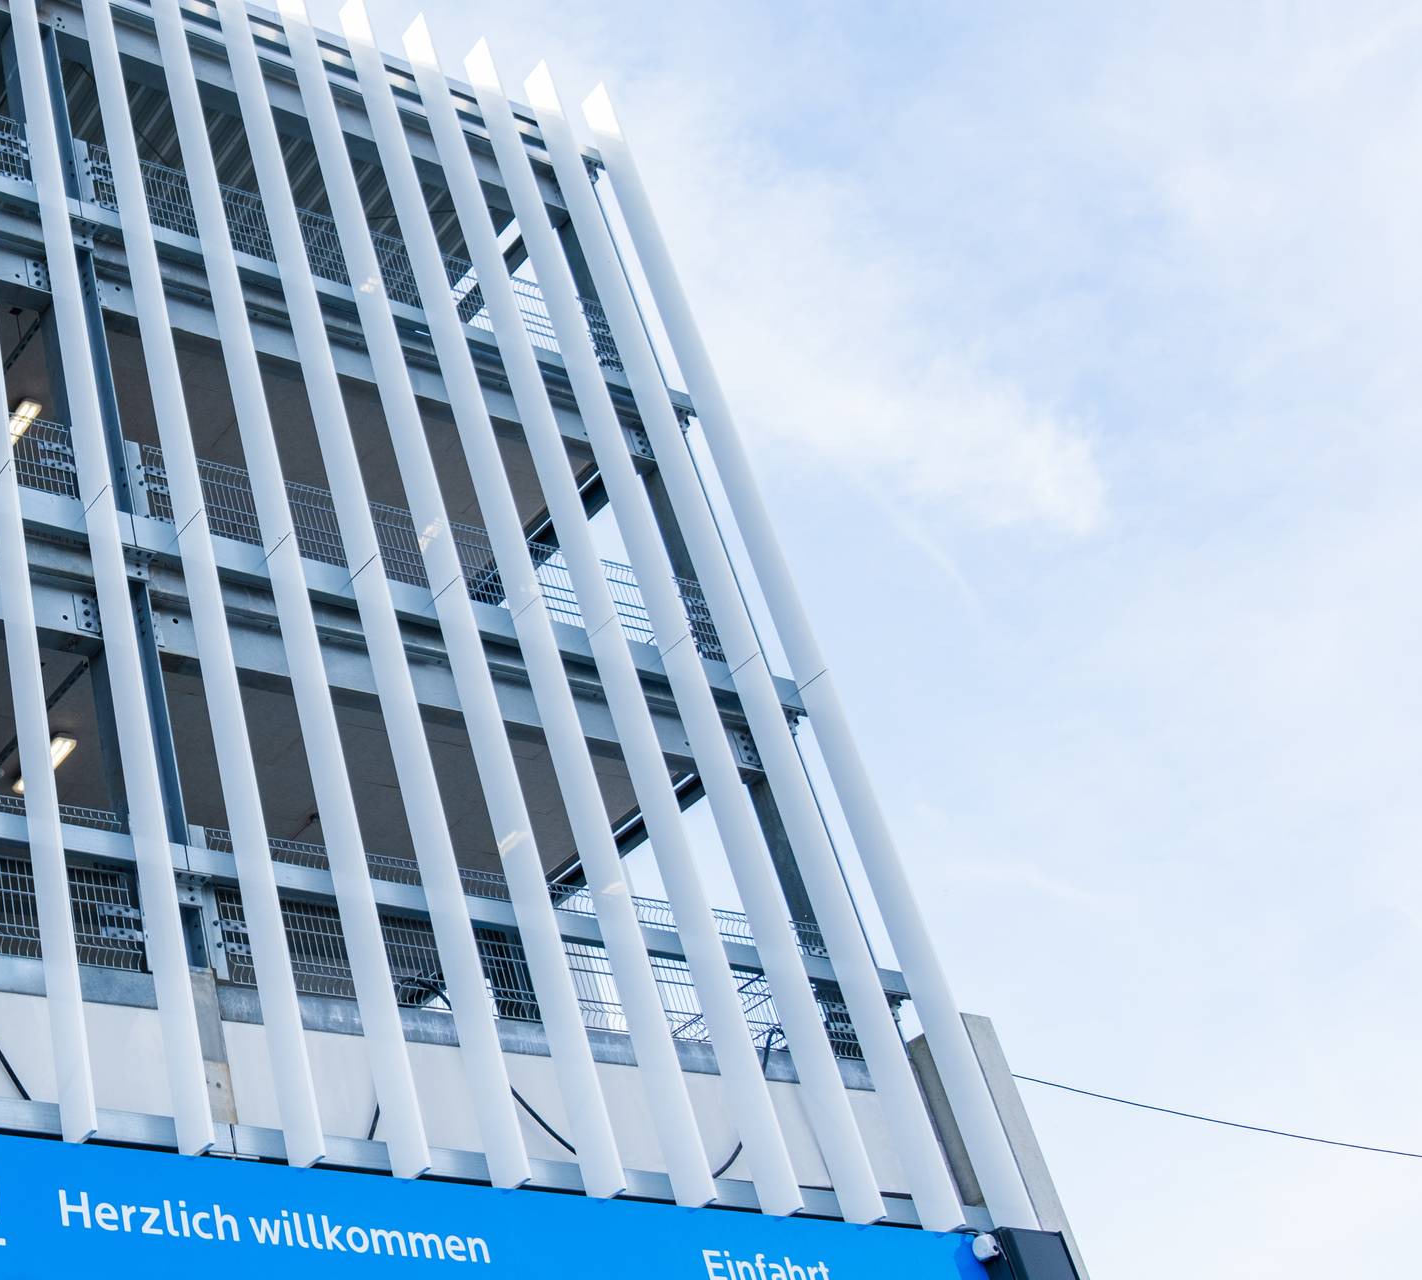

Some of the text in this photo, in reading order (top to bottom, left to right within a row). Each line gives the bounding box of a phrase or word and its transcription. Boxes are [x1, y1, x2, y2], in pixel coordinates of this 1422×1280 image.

[58, 1189, 491, 1264] Herzlich willkommen
[702, 1249, 830, 1280] Einfahrt
